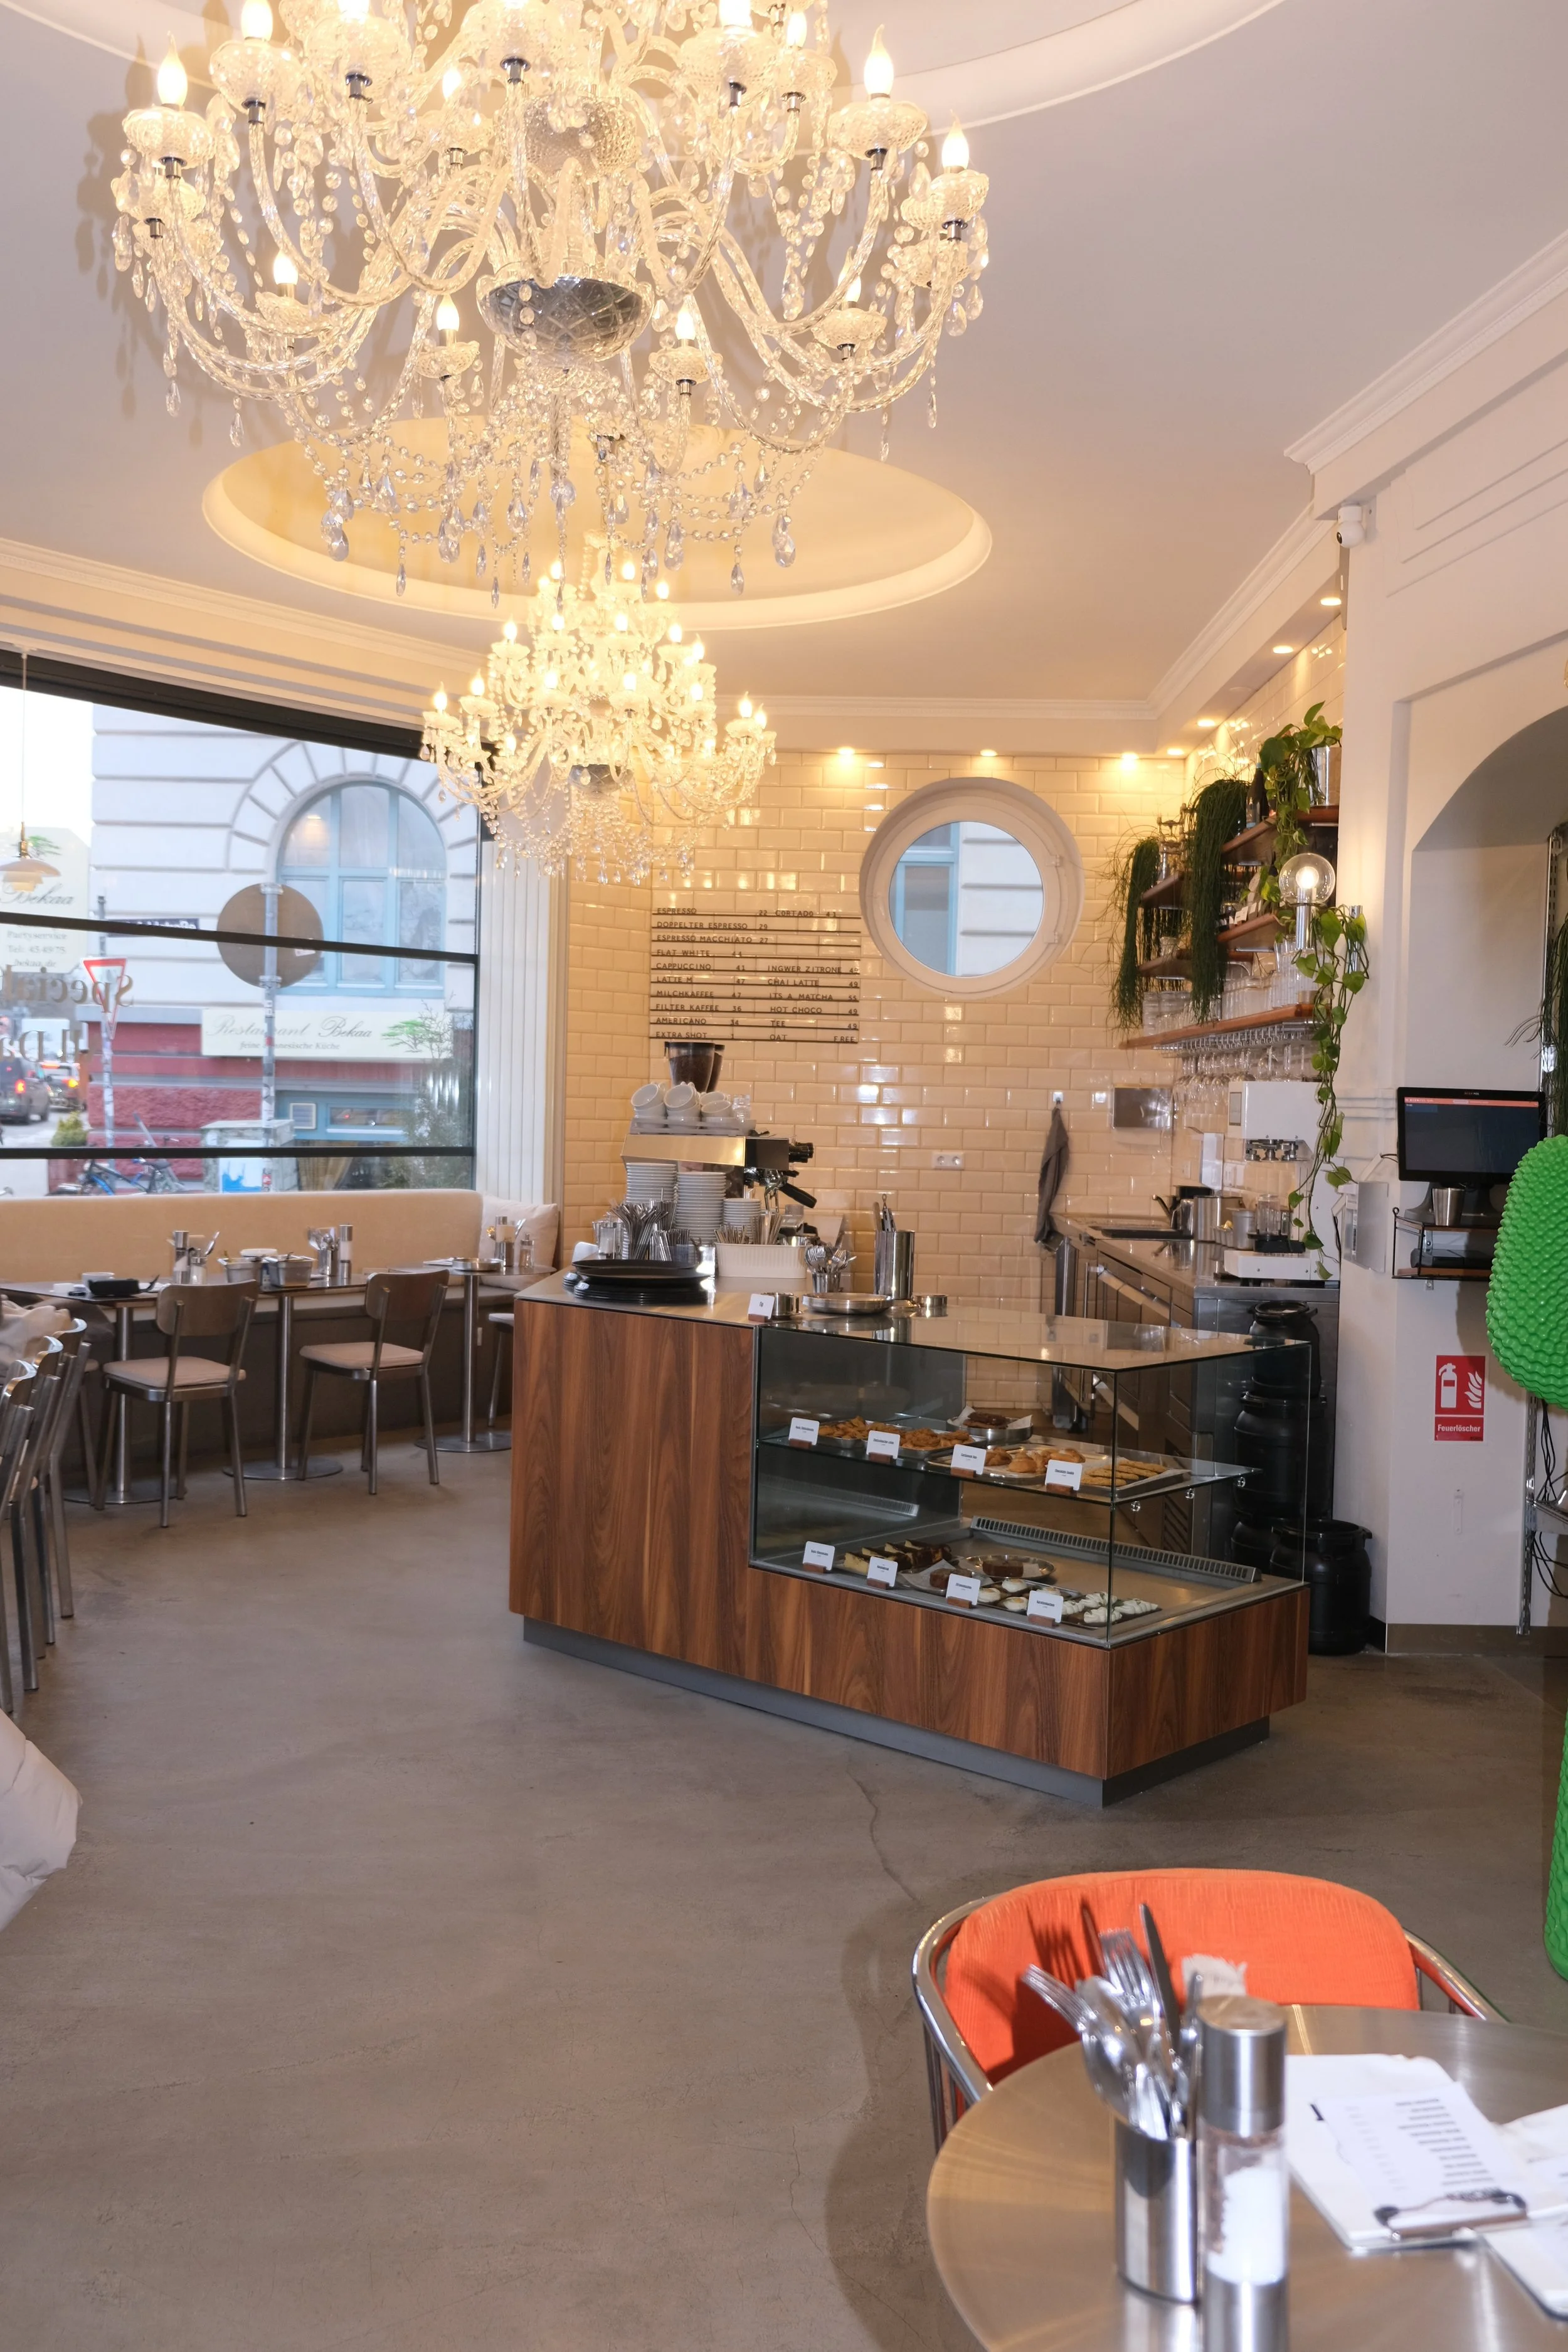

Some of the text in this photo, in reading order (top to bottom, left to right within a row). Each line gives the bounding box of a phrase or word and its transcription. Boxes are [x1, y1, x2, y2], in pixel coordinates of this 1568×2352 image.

[206, 1014, 372, 1037] Restaant Bekaa
[1438, 1424, 1481, 1432] Feuerlöscher
